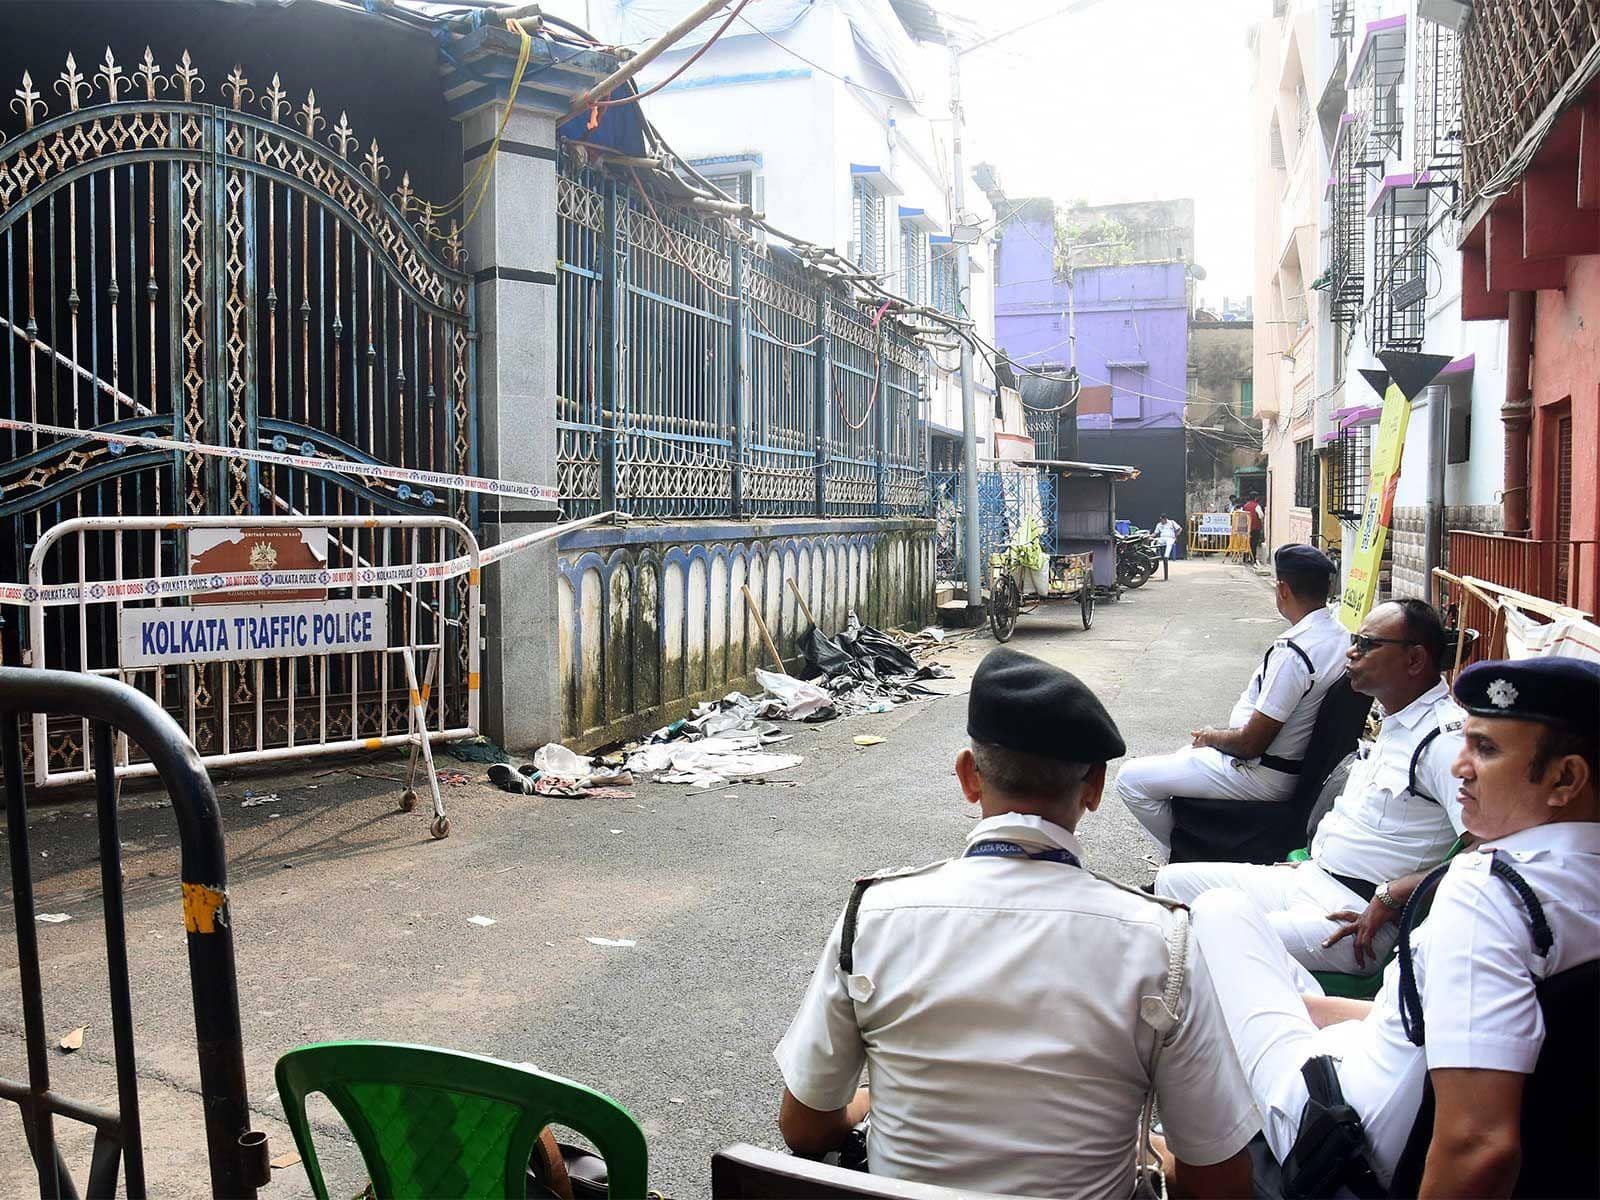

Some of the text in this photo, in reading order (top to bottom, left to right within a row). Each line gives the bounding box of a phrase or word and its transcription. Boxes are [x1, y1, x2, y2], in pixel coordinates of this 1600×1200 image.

[6, 587, 21, 600] CROSS
[40, 588, 67, 600] KOLKATA
[107, 585, 115, 596] DO
[115, 584, 126, 595] NOT
[126, 583, 144, 595] CROSS
[161, 579, 188, 592] KOLKATA
[188, 578, 208, 590] POLICE
[226, 576, 232, 587] DO
[233, 576, 243, 587] NOT
[243, 575, 259, 586] CROSS
[274, 574, 299, 585] KOLKATA
[299, 573, 317, 583] POLICE
[332, 572, 338, 582] DO
[339, 572, 347, 581] NOT
[376, 570, 398, 581] KOLKATA
[398, 569, 414, 579] POLICE
[429, 567, 435, 576] DO
[142, 612, 372, 656] KOLKATA TRAFFIC POLICE
